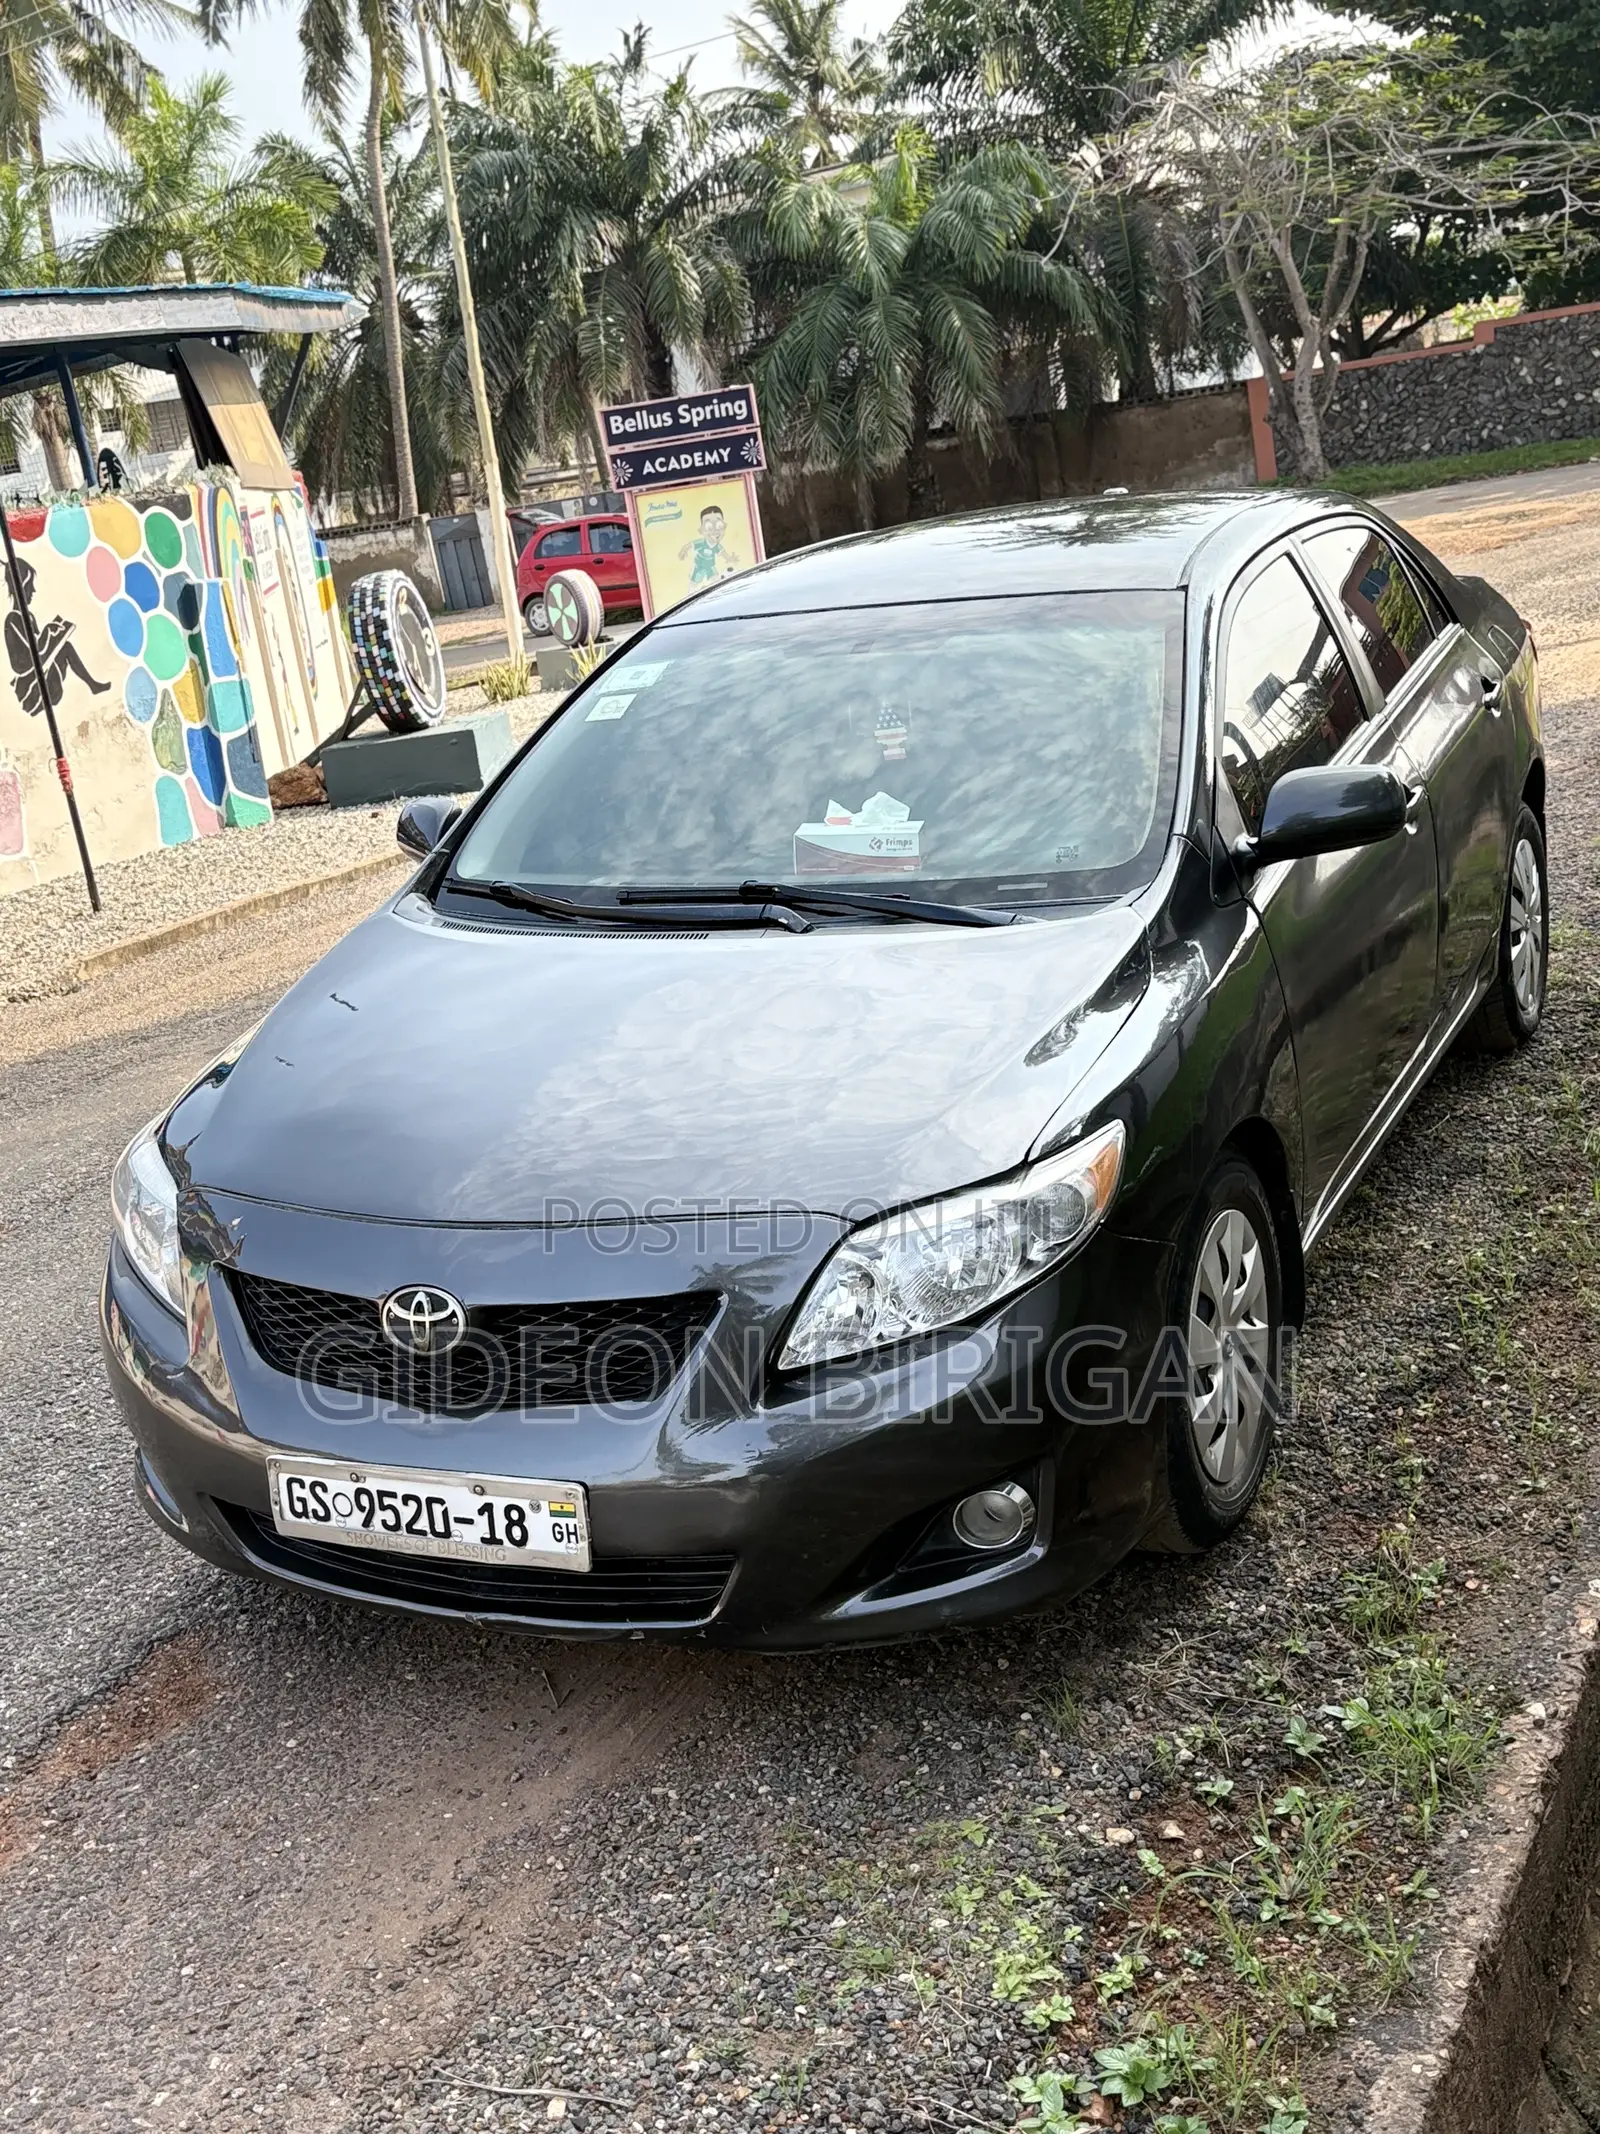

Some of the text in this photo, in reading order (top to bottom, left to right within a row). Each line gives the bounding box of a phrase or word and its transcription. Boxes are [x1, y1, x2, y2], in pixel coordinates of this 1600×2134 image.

[609, 398, 748, 435] Bellus Spring
[642, 447, 731, 475] ACADEMY
[885, 837, 913, 848] Frimps
[286, 1477, 331, 1523] GS
[346, 1531, 507, 1562] SHOWERS OF BLESSING
[552, 1522, 579, 1544] GH
